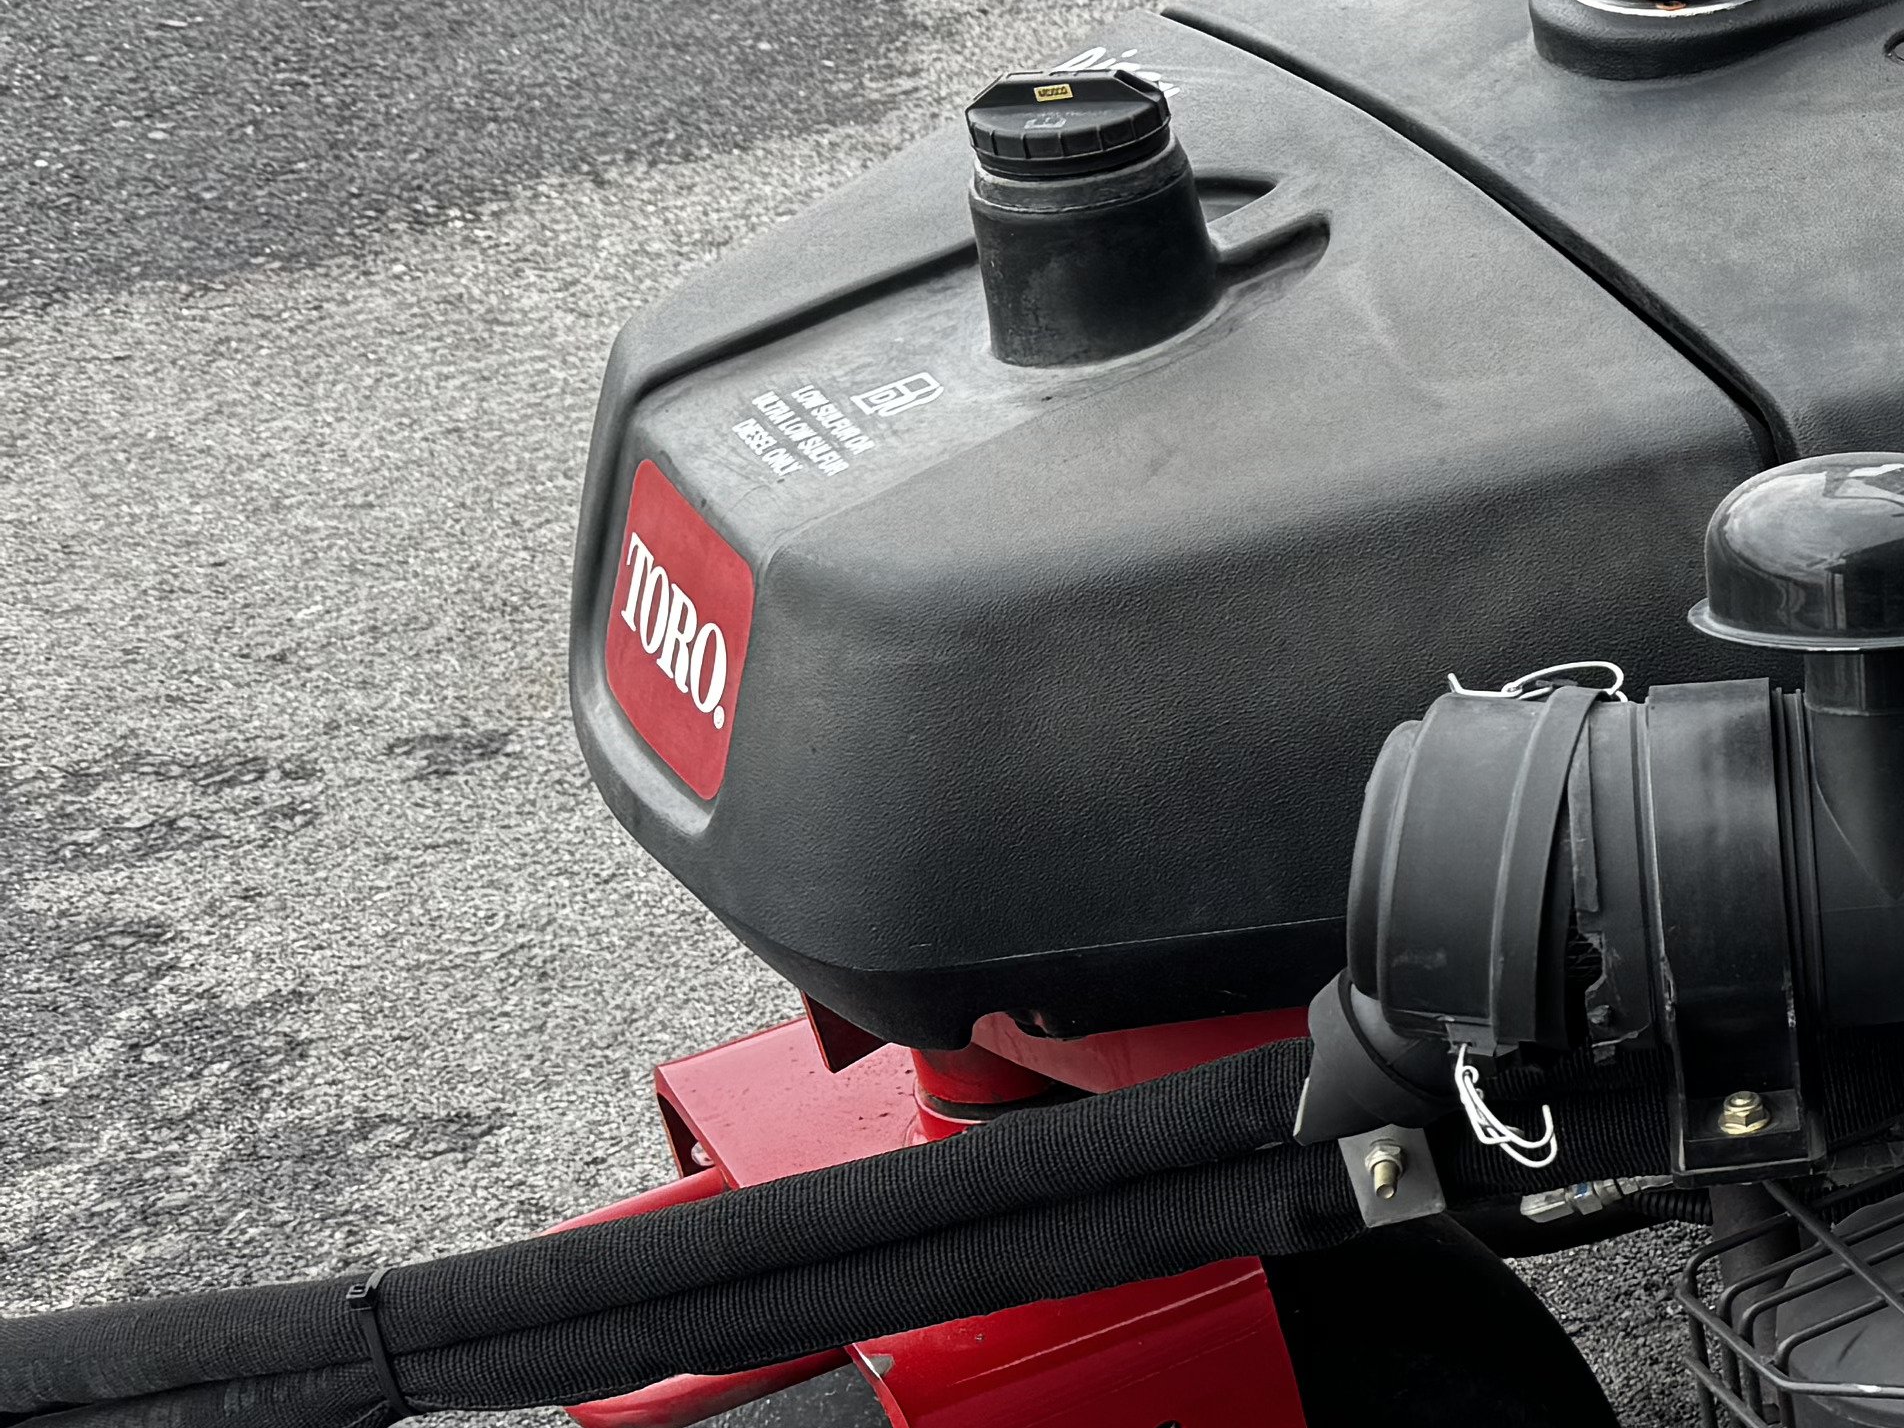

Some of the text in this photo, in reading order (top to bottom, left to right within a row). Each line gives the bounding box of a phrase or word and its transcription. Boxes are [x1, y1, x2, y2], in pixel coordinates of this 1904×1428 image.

[732, 418, 803, 477] DIESEL ONLY
[752, 391, 849, 476] ULTRA LOW SULFUR
[791, 385, 829, 409] LOW
[811, 403, 861, 441] SULFUR
[621, 532, 727, 714] TORO
